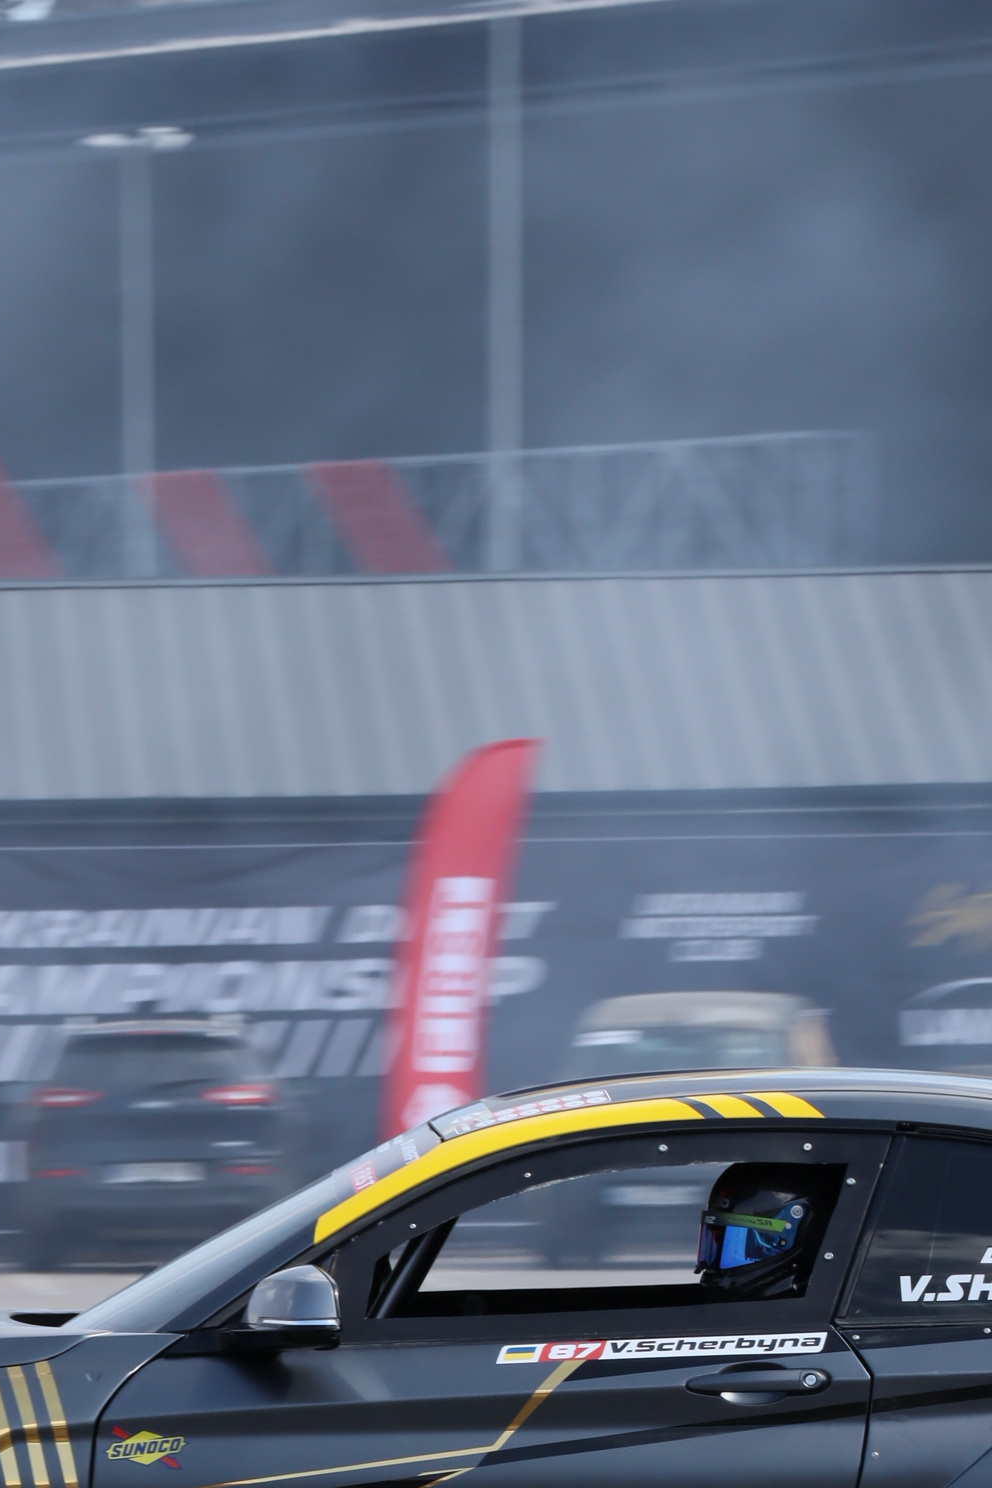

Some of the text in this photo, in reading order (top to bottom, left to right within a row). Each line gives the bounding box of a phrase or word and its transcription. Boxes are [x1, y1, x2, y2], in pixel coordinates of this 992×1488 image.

[548, 1337, 821, 1360] 87 V.Scherbyna
[110, 1438, 182, 1458] SUNOCO
